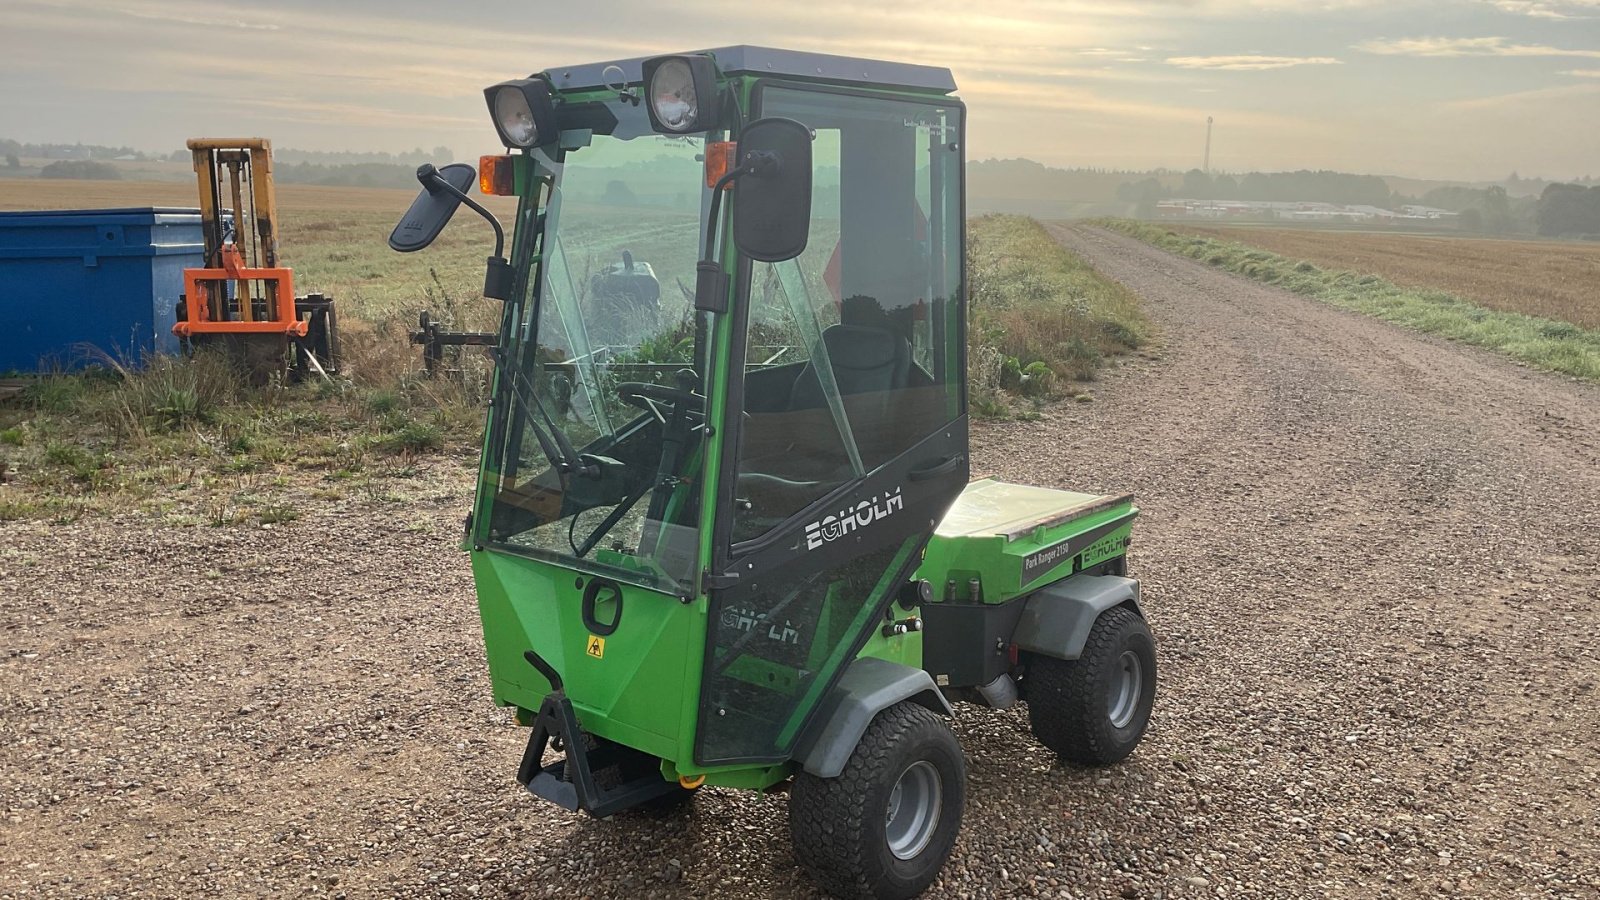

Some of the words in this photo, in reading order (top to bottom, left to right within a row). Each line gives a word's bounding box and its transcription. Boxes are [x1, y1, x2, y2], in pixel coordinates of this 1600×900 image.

[805, 486, 903, 550] EGHOLM
[1025, 555, 1038, 570] Park
[1038, 549, 1056, 565] Ranger
[1056, 542, 1069, 557] 2150
